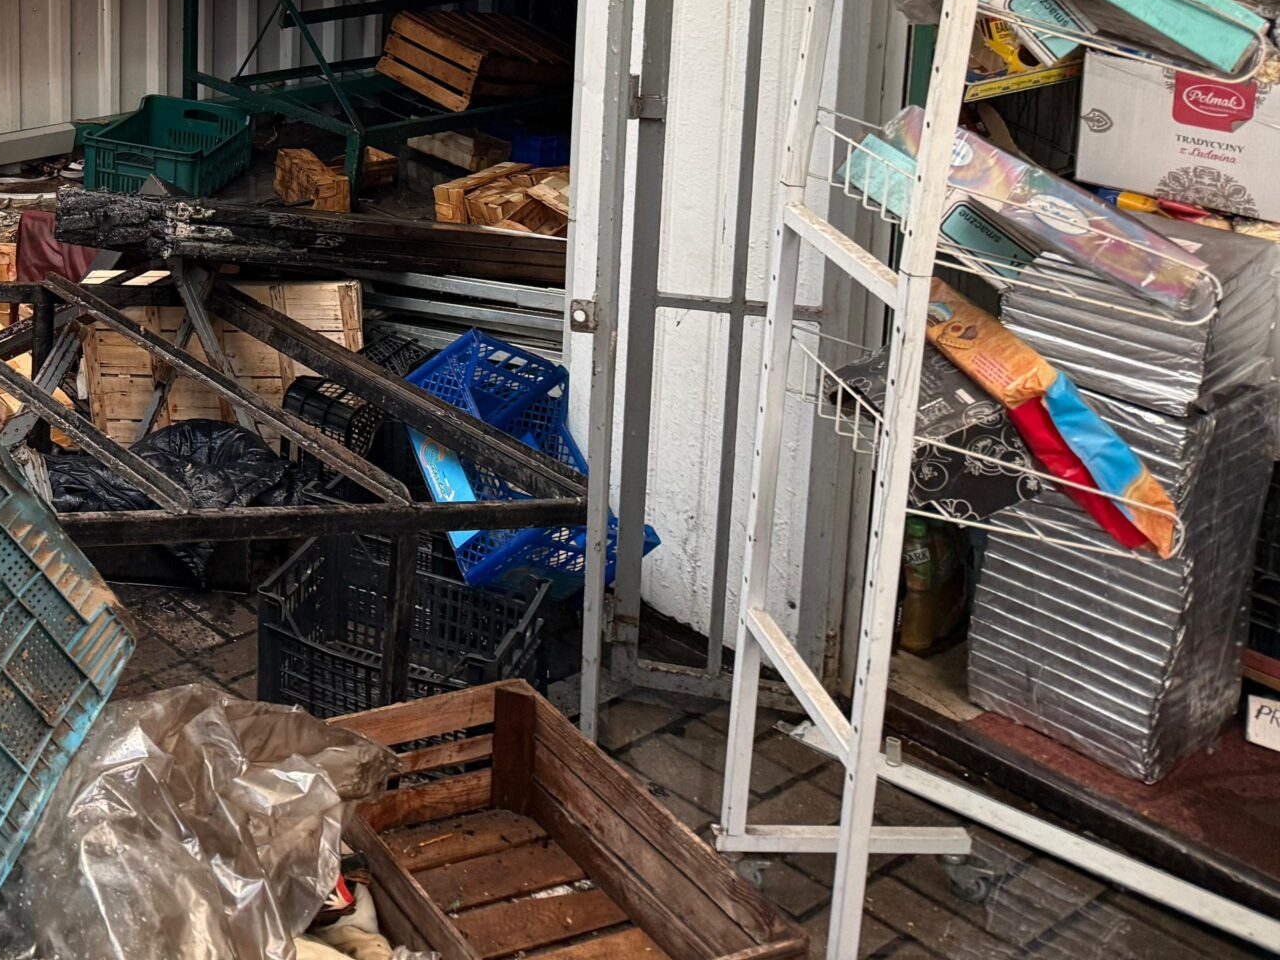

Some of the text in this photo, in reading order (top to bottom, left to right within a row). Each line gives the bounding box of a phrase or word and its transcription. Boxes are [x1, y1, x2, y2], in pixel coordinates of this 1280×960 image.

[1188, 88, 1238, 108] Polmak
[1176, 133, 1246, 154] TRADYCYJNY
[958, 208, 1003, 244] smaczne
